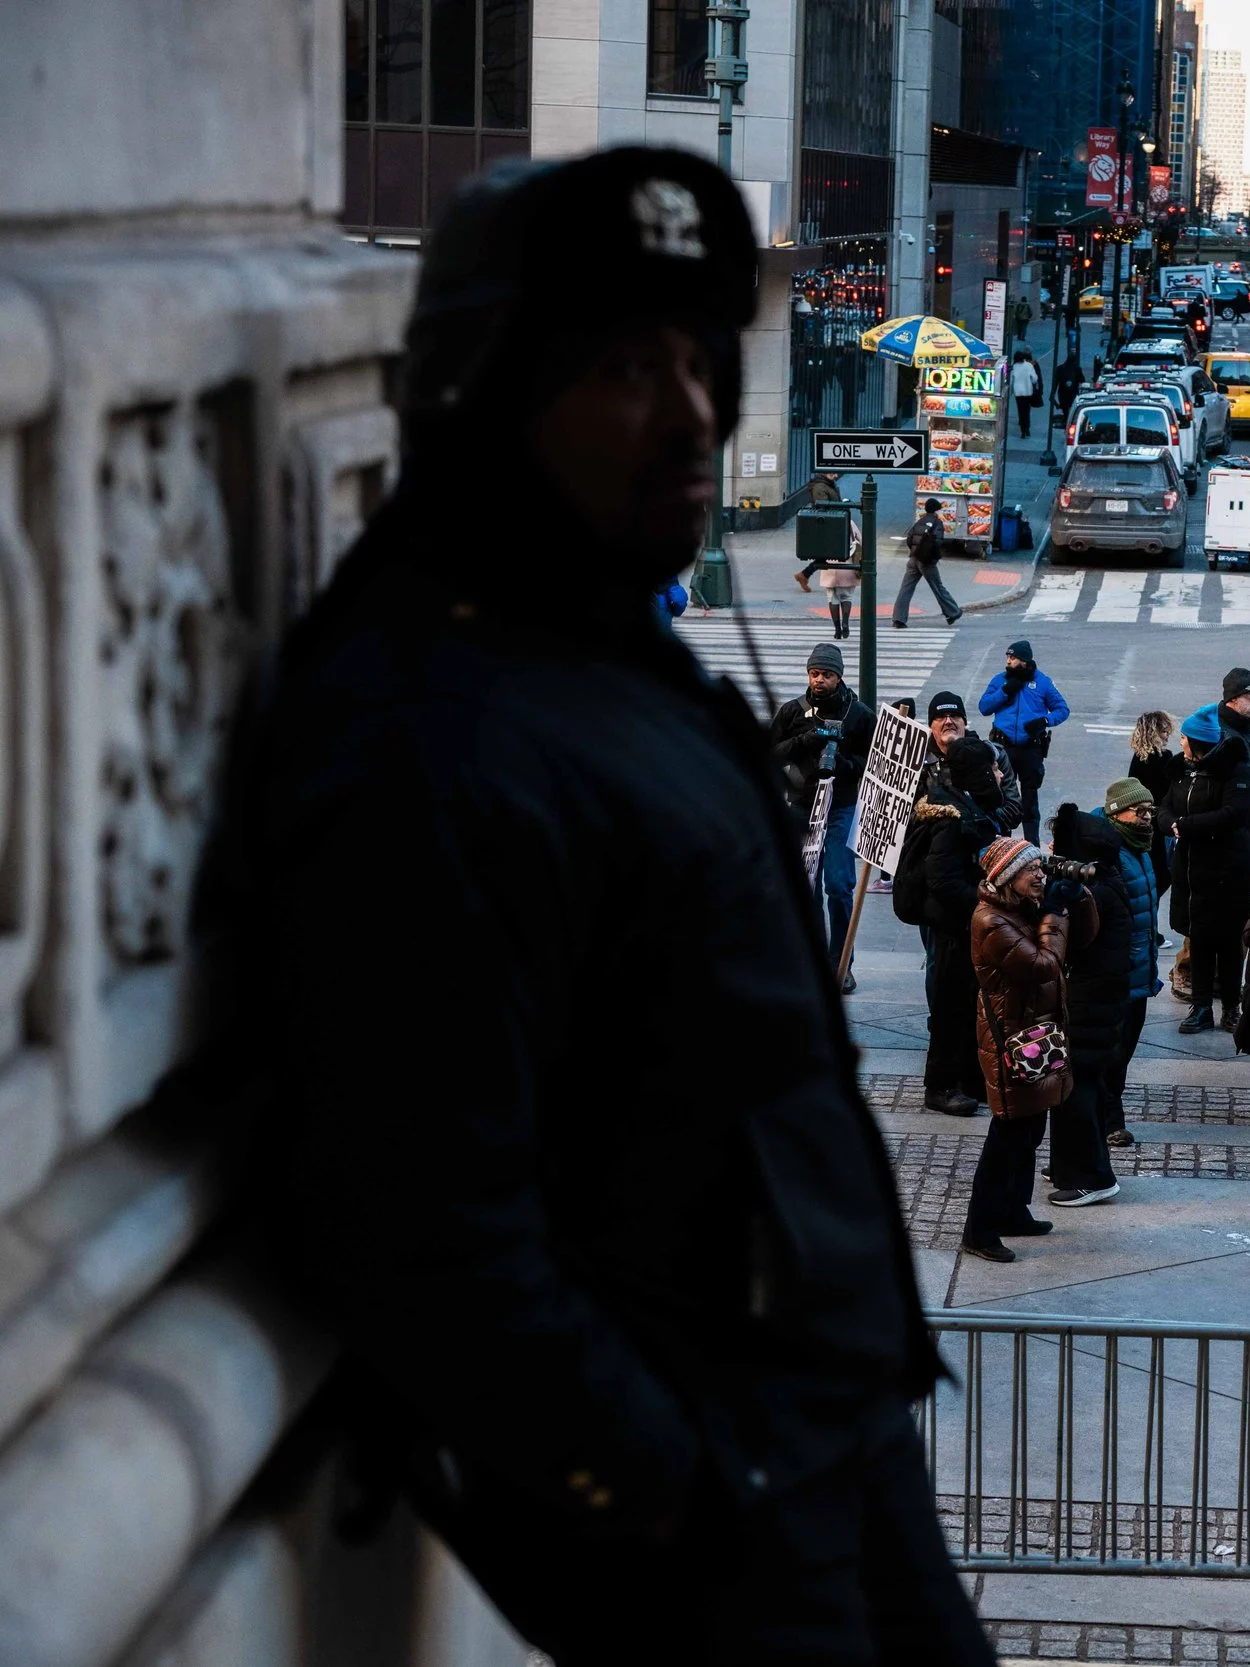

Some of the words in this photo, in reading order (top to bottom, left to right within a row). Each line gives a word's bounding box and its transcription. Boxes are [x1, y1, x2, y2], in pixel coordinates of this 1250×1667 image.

[1090, 133, 1115, 142] Library
[1167, 274, 1203, 286] FedEx
[917, 355, 967, 365] SABRETT
[930, 370, 991, 392] OPEN
[833, 445, 861, 458] ONE
[875, 446, 908, 459] WAY
[873, 709, 928, 772] DEFEND
[866, 749, 918, 798] DEMOCRACY:
[860, 776, 876, 806] IT'S
[874, 784, 893, 817] TIME
[890, 794, 912, 827] FOR
[858, 803, 866, 827] A
[863, 807, 901, 847] GENERAL
[857, 830, 889, 867] STRIKE!
